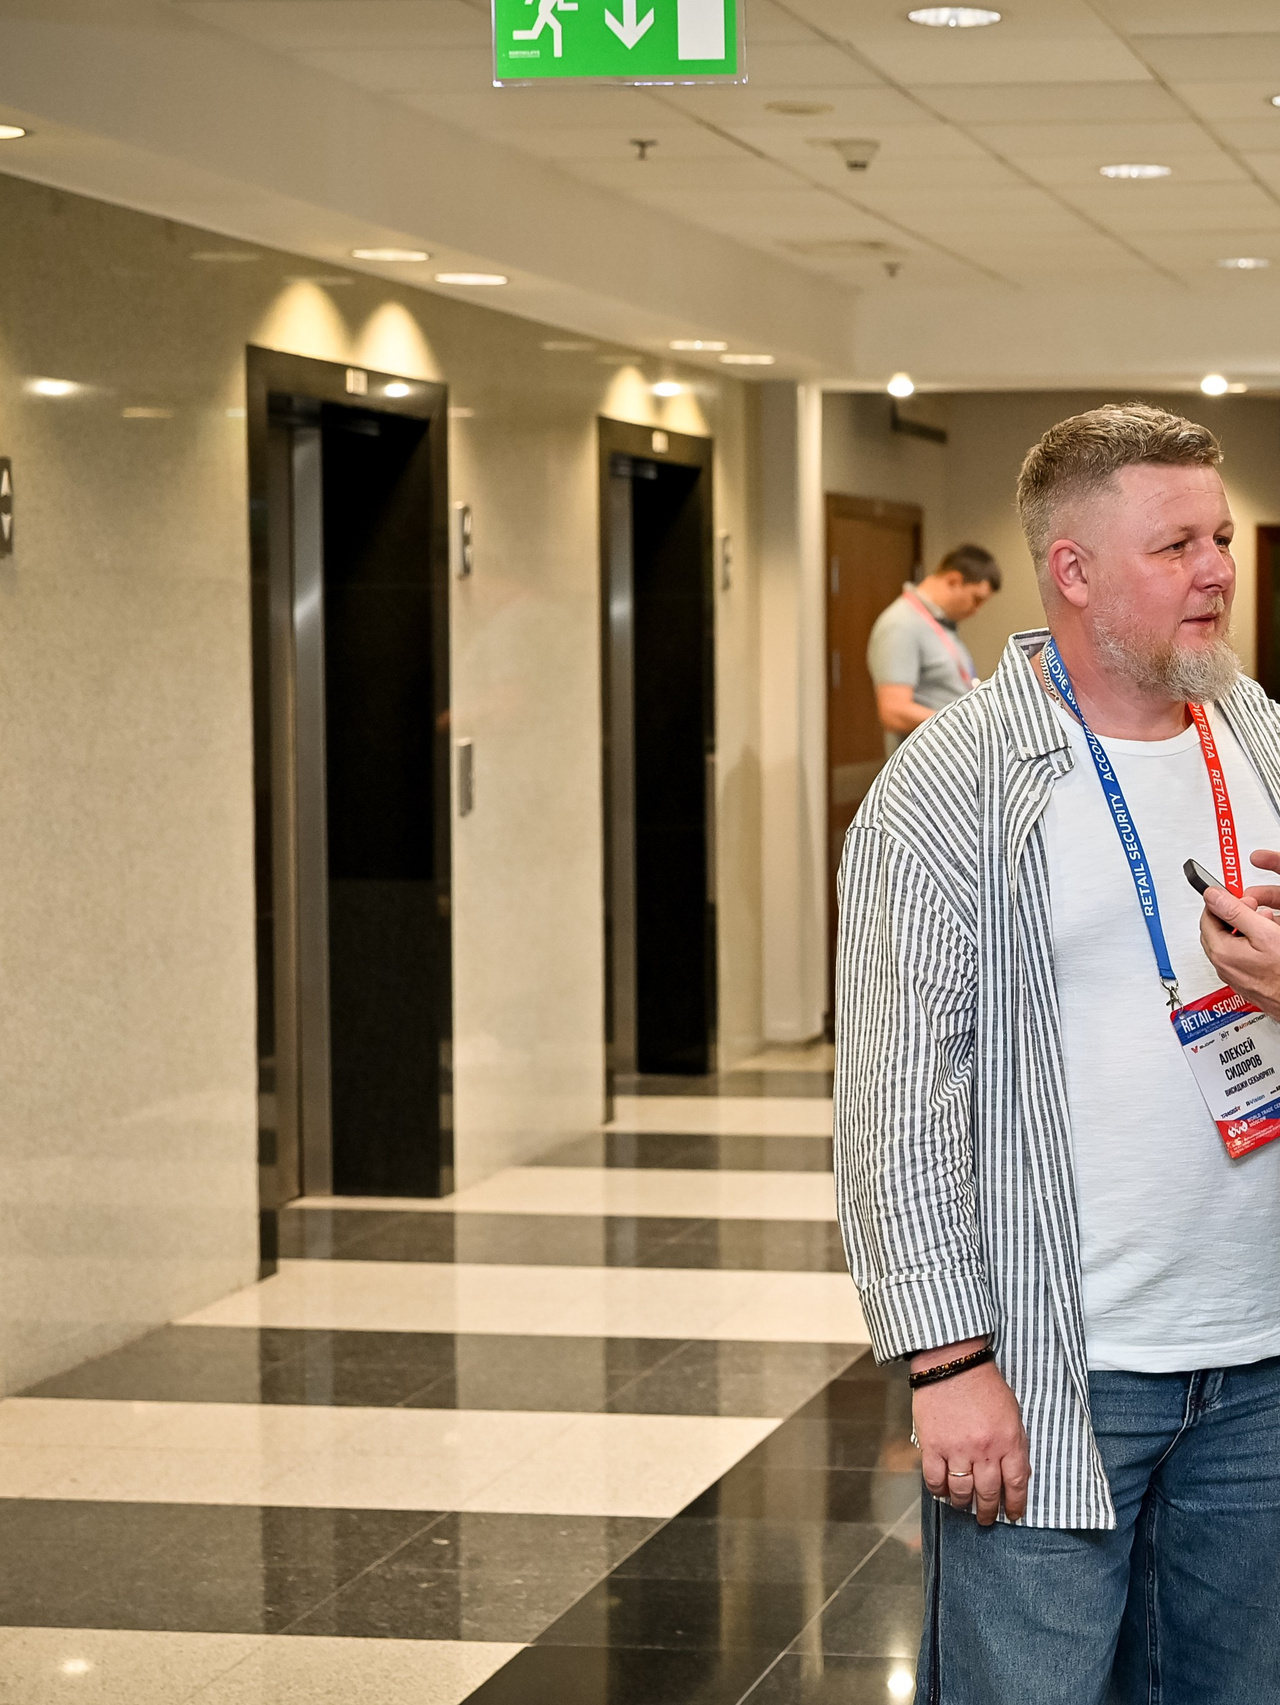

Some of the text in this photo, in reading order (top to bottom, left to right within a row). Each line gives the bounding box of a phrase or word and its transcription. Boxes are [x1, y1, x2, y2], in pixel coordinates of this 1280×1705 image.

[1109, 793, 1142, 860] SECURITY
[1211, 769, 1239, 888] RETAIL SECURITY
[1132, 862, 1154, 917] RETAIL
[1180, 1009, 1214, 1034] RETAIL
[1212, 993, 1249, 1017] SECURI
[1219, 1036, 1256, 1065] АЛЕКСЕЙ
[1224, 1054, 1263, 1081] СИДОРОВ
[1247, 1112, 1261, 1123] WORLD
[1261, 1106, 1273, 1117] TRADE
